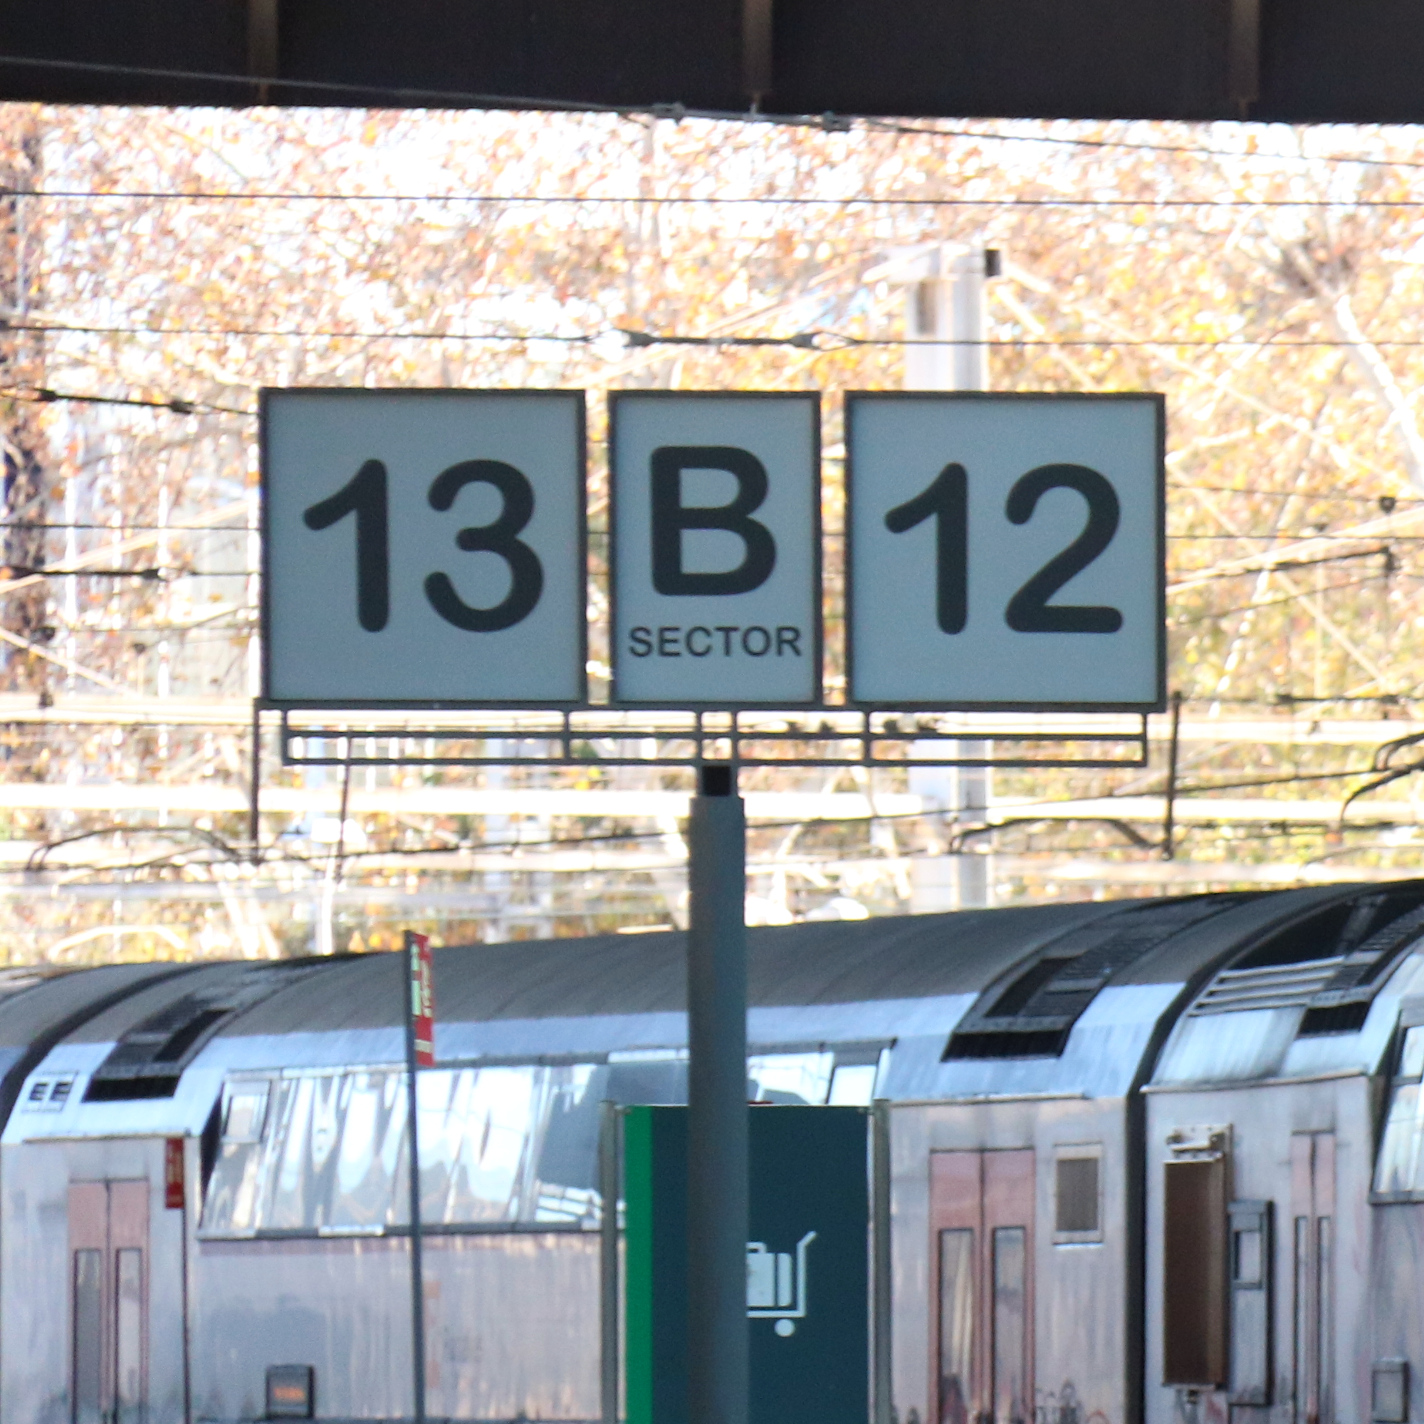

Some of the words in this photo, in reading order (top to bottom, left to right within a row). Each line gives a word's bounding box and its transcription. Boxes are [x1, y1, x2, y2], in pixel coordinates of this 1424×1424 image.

[303, 458, 545, 633] 13
[649, 445, 778, 596] B
[884, 462, 1124, 635] 12
[628, 625, 802, 658] SECTOR
